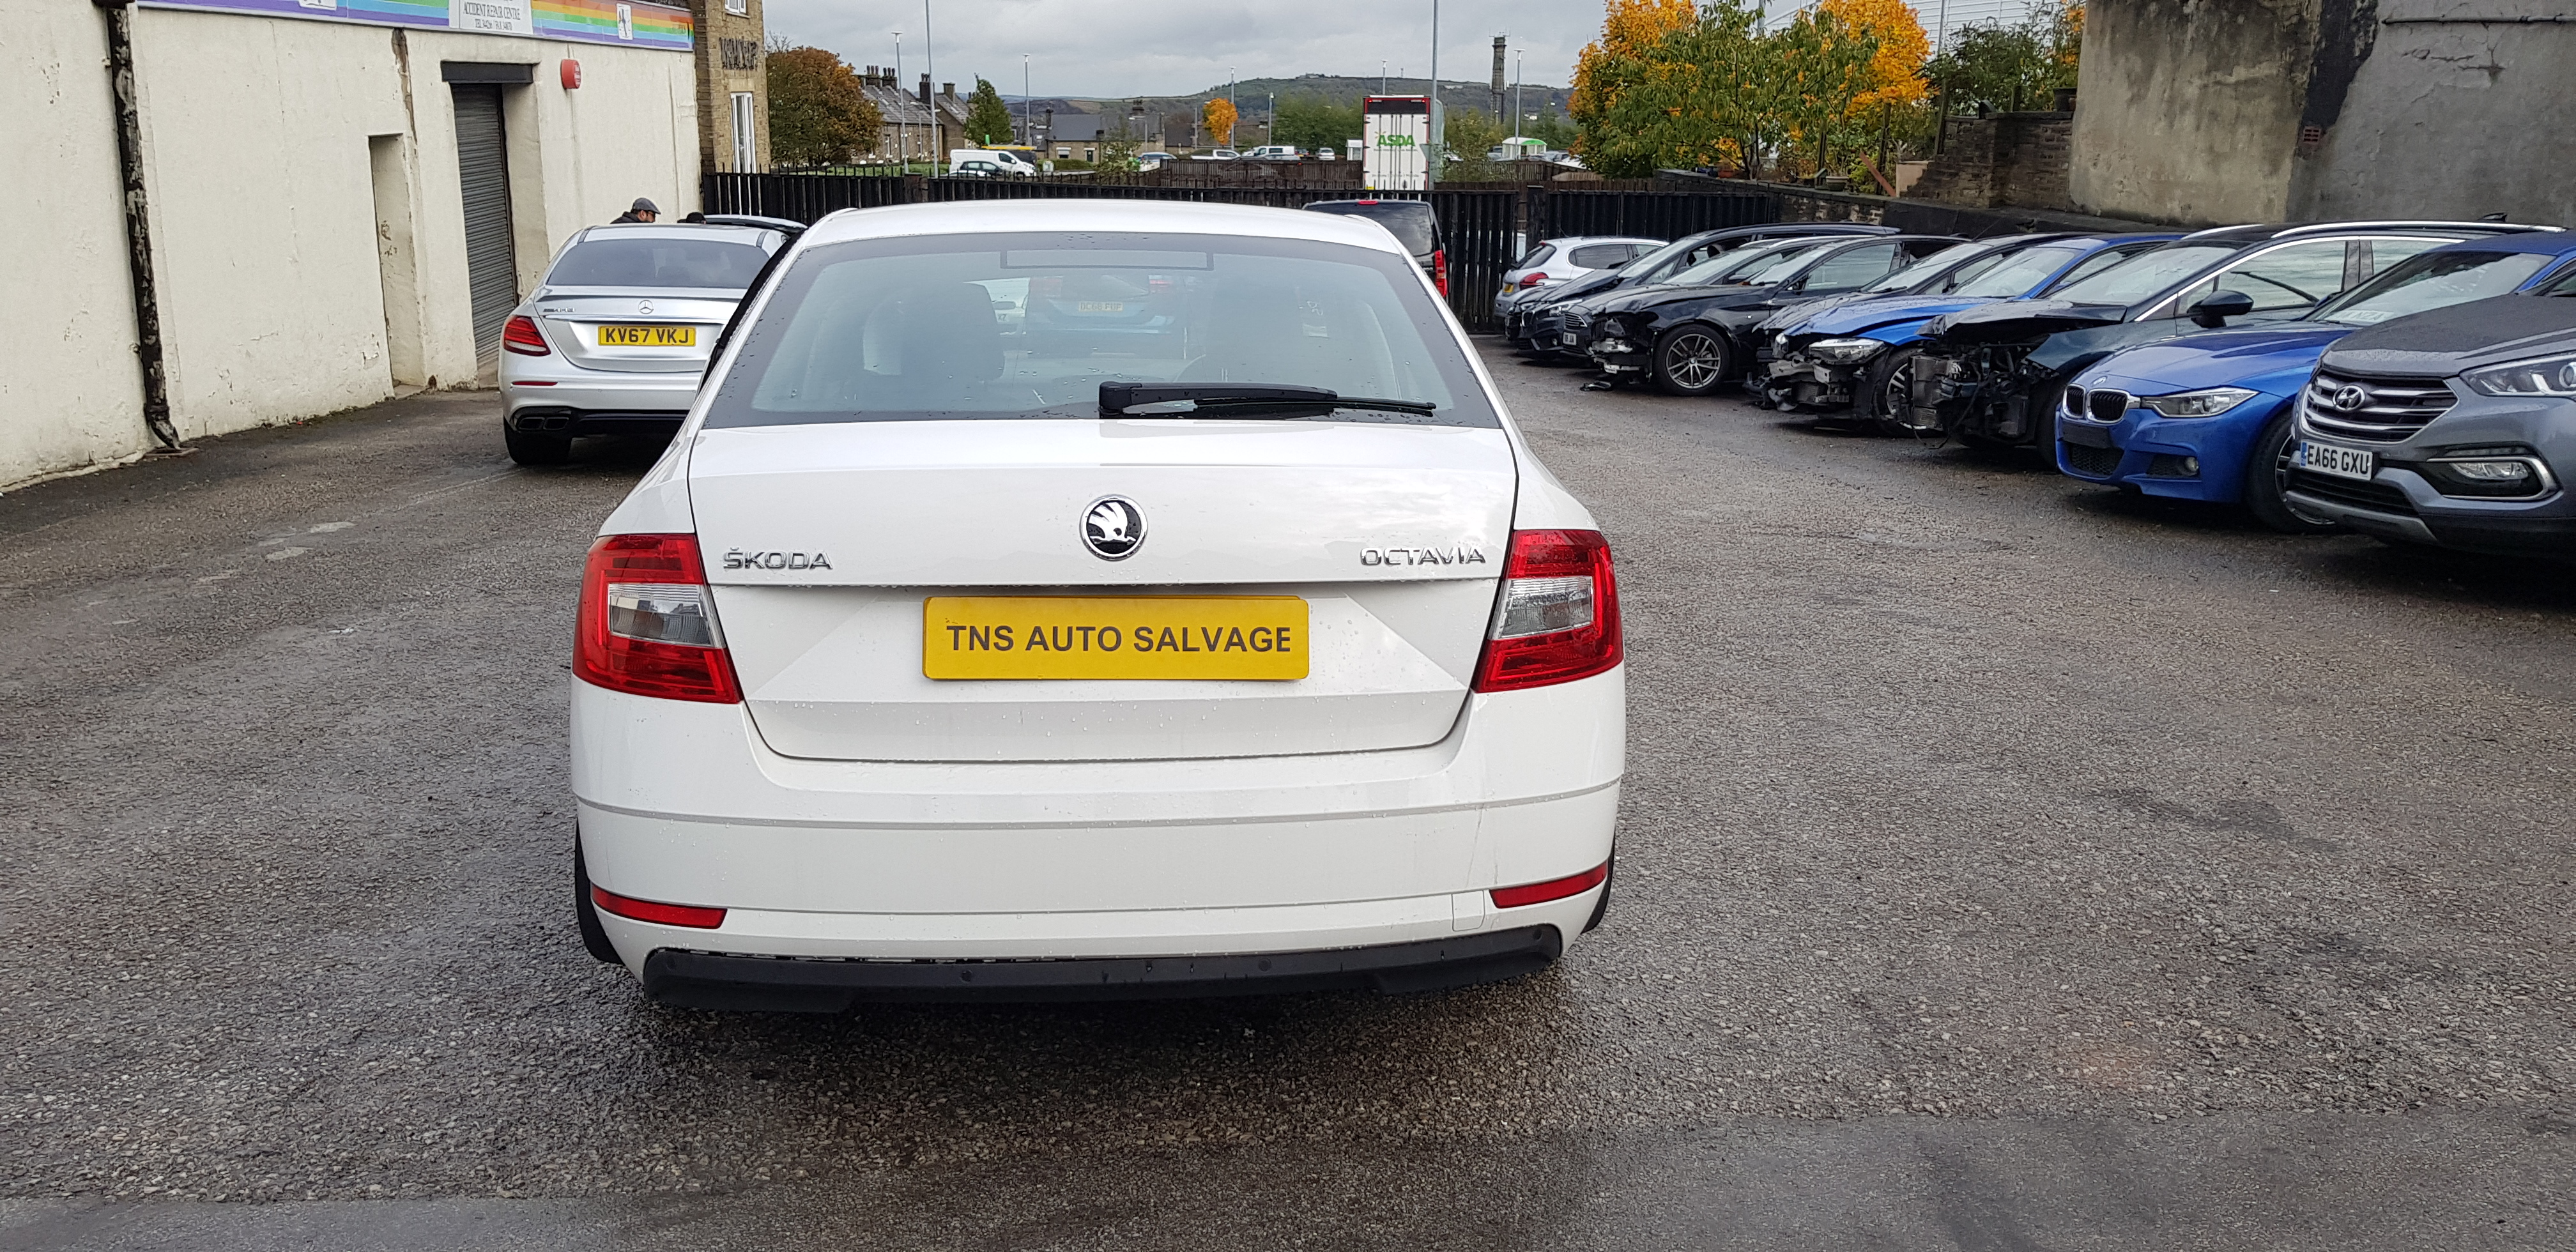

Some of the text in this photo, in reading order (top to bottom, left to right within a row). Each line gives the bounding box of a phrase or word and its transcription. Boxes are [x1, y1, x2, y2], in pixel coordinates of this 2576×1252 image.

[487, 4, 503, 18] REPAIR
[504, 6, 520, 20] CENTRE
[1376, 134, 1415, 146] ASDA
[606, 328, 689, 344] KV67 VKJ
[2307, 445, 2369, 474] EA66 GXU
[723, 547, 833, 570] ŠKODA
[1360, 547, 1486, 565] OCTAVIA
[946, 625, 1291, 652] TNS AUTO SALVAGE
